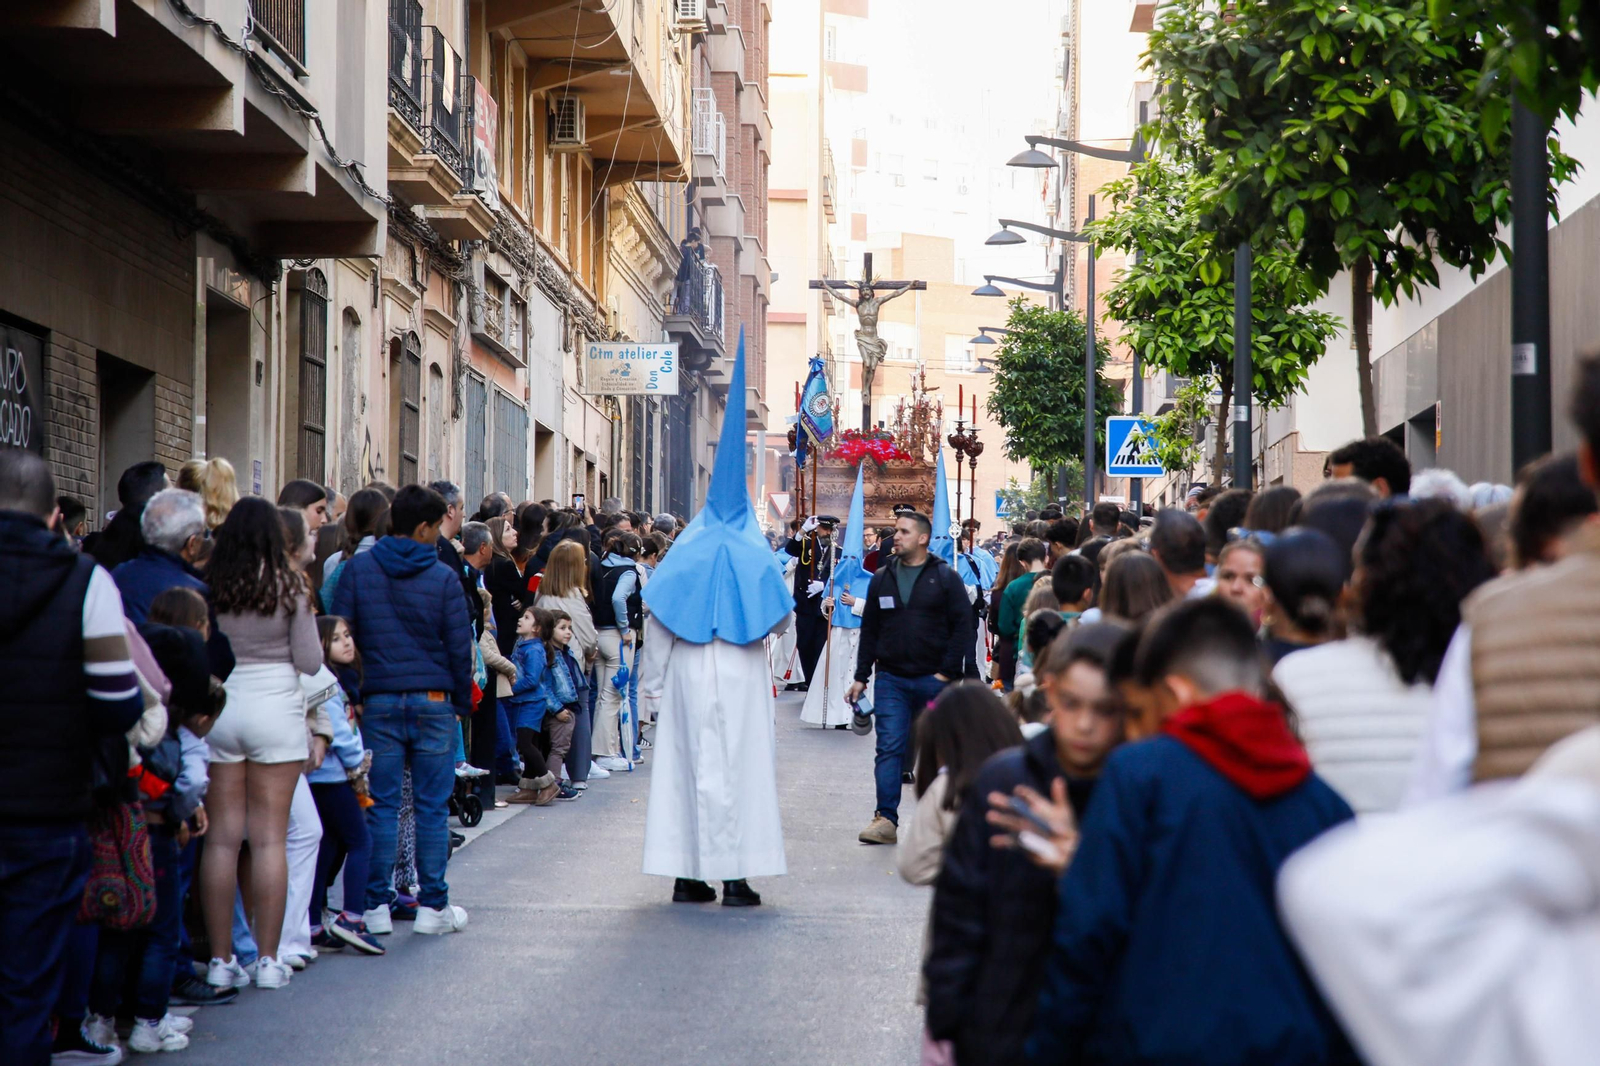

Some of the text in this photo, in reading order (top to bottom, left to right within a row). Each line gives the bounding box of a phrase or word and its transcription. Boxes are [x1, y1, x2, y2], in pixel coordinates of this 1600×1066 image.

[589, 346, 658, 360] Ctm atelier
[660, 350, 673, 373] Cole
[645, 370, 658, 390] Don
